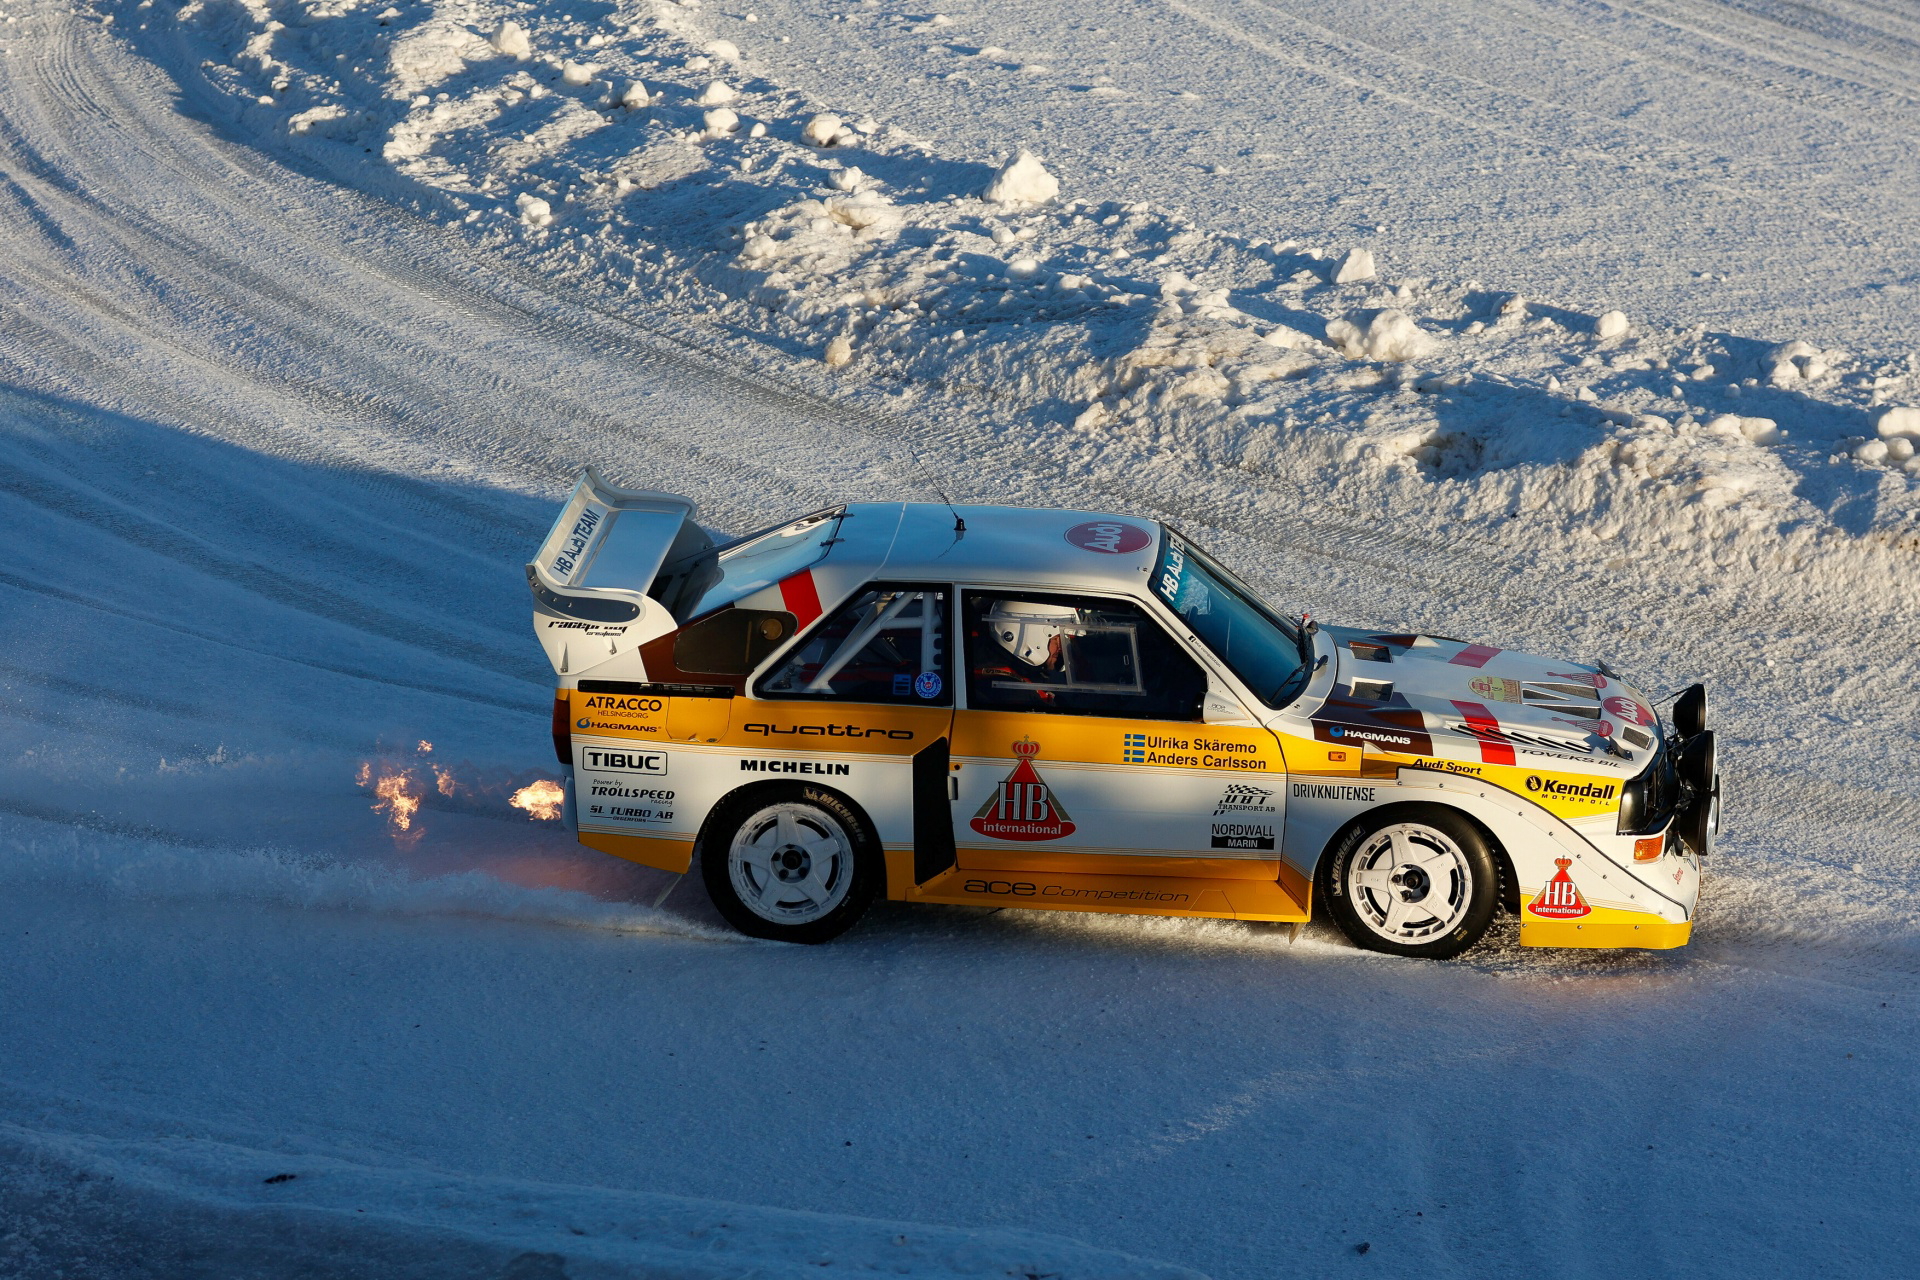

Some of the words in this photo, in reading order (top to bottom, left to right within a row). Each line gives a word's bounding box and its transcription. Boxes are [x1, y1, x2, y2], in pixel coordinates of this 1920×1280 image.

[553, 556, 574, 576] HB
[572, 508, 601, 540] TEAM
[1084, 523, 1123, 553] Audi
[1160, 573, 1179, 602] HB
[585, 696, 663, 713] ATRACCO
[1615, 698, 1639, 725] Audi
[597, 709, 649, 719] HELSINGBORG
[743, 723, 914, 741] quattro
[1344, 729, 1412, 745] HAGMANS
[1147, 736, 1189, 750] Ulrika
[1193, 738, 1257, 754] Skäremo
[588, 752, 661, 771] TIBUC
[740, 759, 850, 776] MICHELIN
[1147, 752, 1199, 766] Anders
[1203, 754, 1266, 770] Carlsson
[1412, 758, 1444, 770] Audi
[1446, 761, 1482, 776] Sport
[1520, 748, 1595, 764] TOVEKS
[1598, 760, 1622, 769] BIL
[593, 778, 613, 786] Power
[614, 779, 623, 788] by
[1543, 779, 1615, 800] Kendall
[591, 786, 675, 800] TROLLSPEED
[998, 782, 1049, 822] HB
[1293, 784, 1376, 802] DRIVKNUTENSE
[1541, 793, 1585, 803] MOTOR
[650, 799, 673, 807] racing
[1217, 803, 1263, 812] TRANSPORT
[590, 805, 604, 814] SL
[610, 806, 652, 818] TURBO
[655, 810, 674, 820] AB
[818, 793, 867, 843] MICHELIN
[983, 821, 1062, 835] international
[1211, 823, 1275, 837] NORDWALL
[1227, 838, 1258, 848] MARIN
[1332, 826, 1361, 880] MICHELIN
[963, 879, 1037, 896] ace
[1041, 885, 1190, 902] Competition
[1543, 880, 1577, 906] HB
[1535, 905, 1583, 915] international
